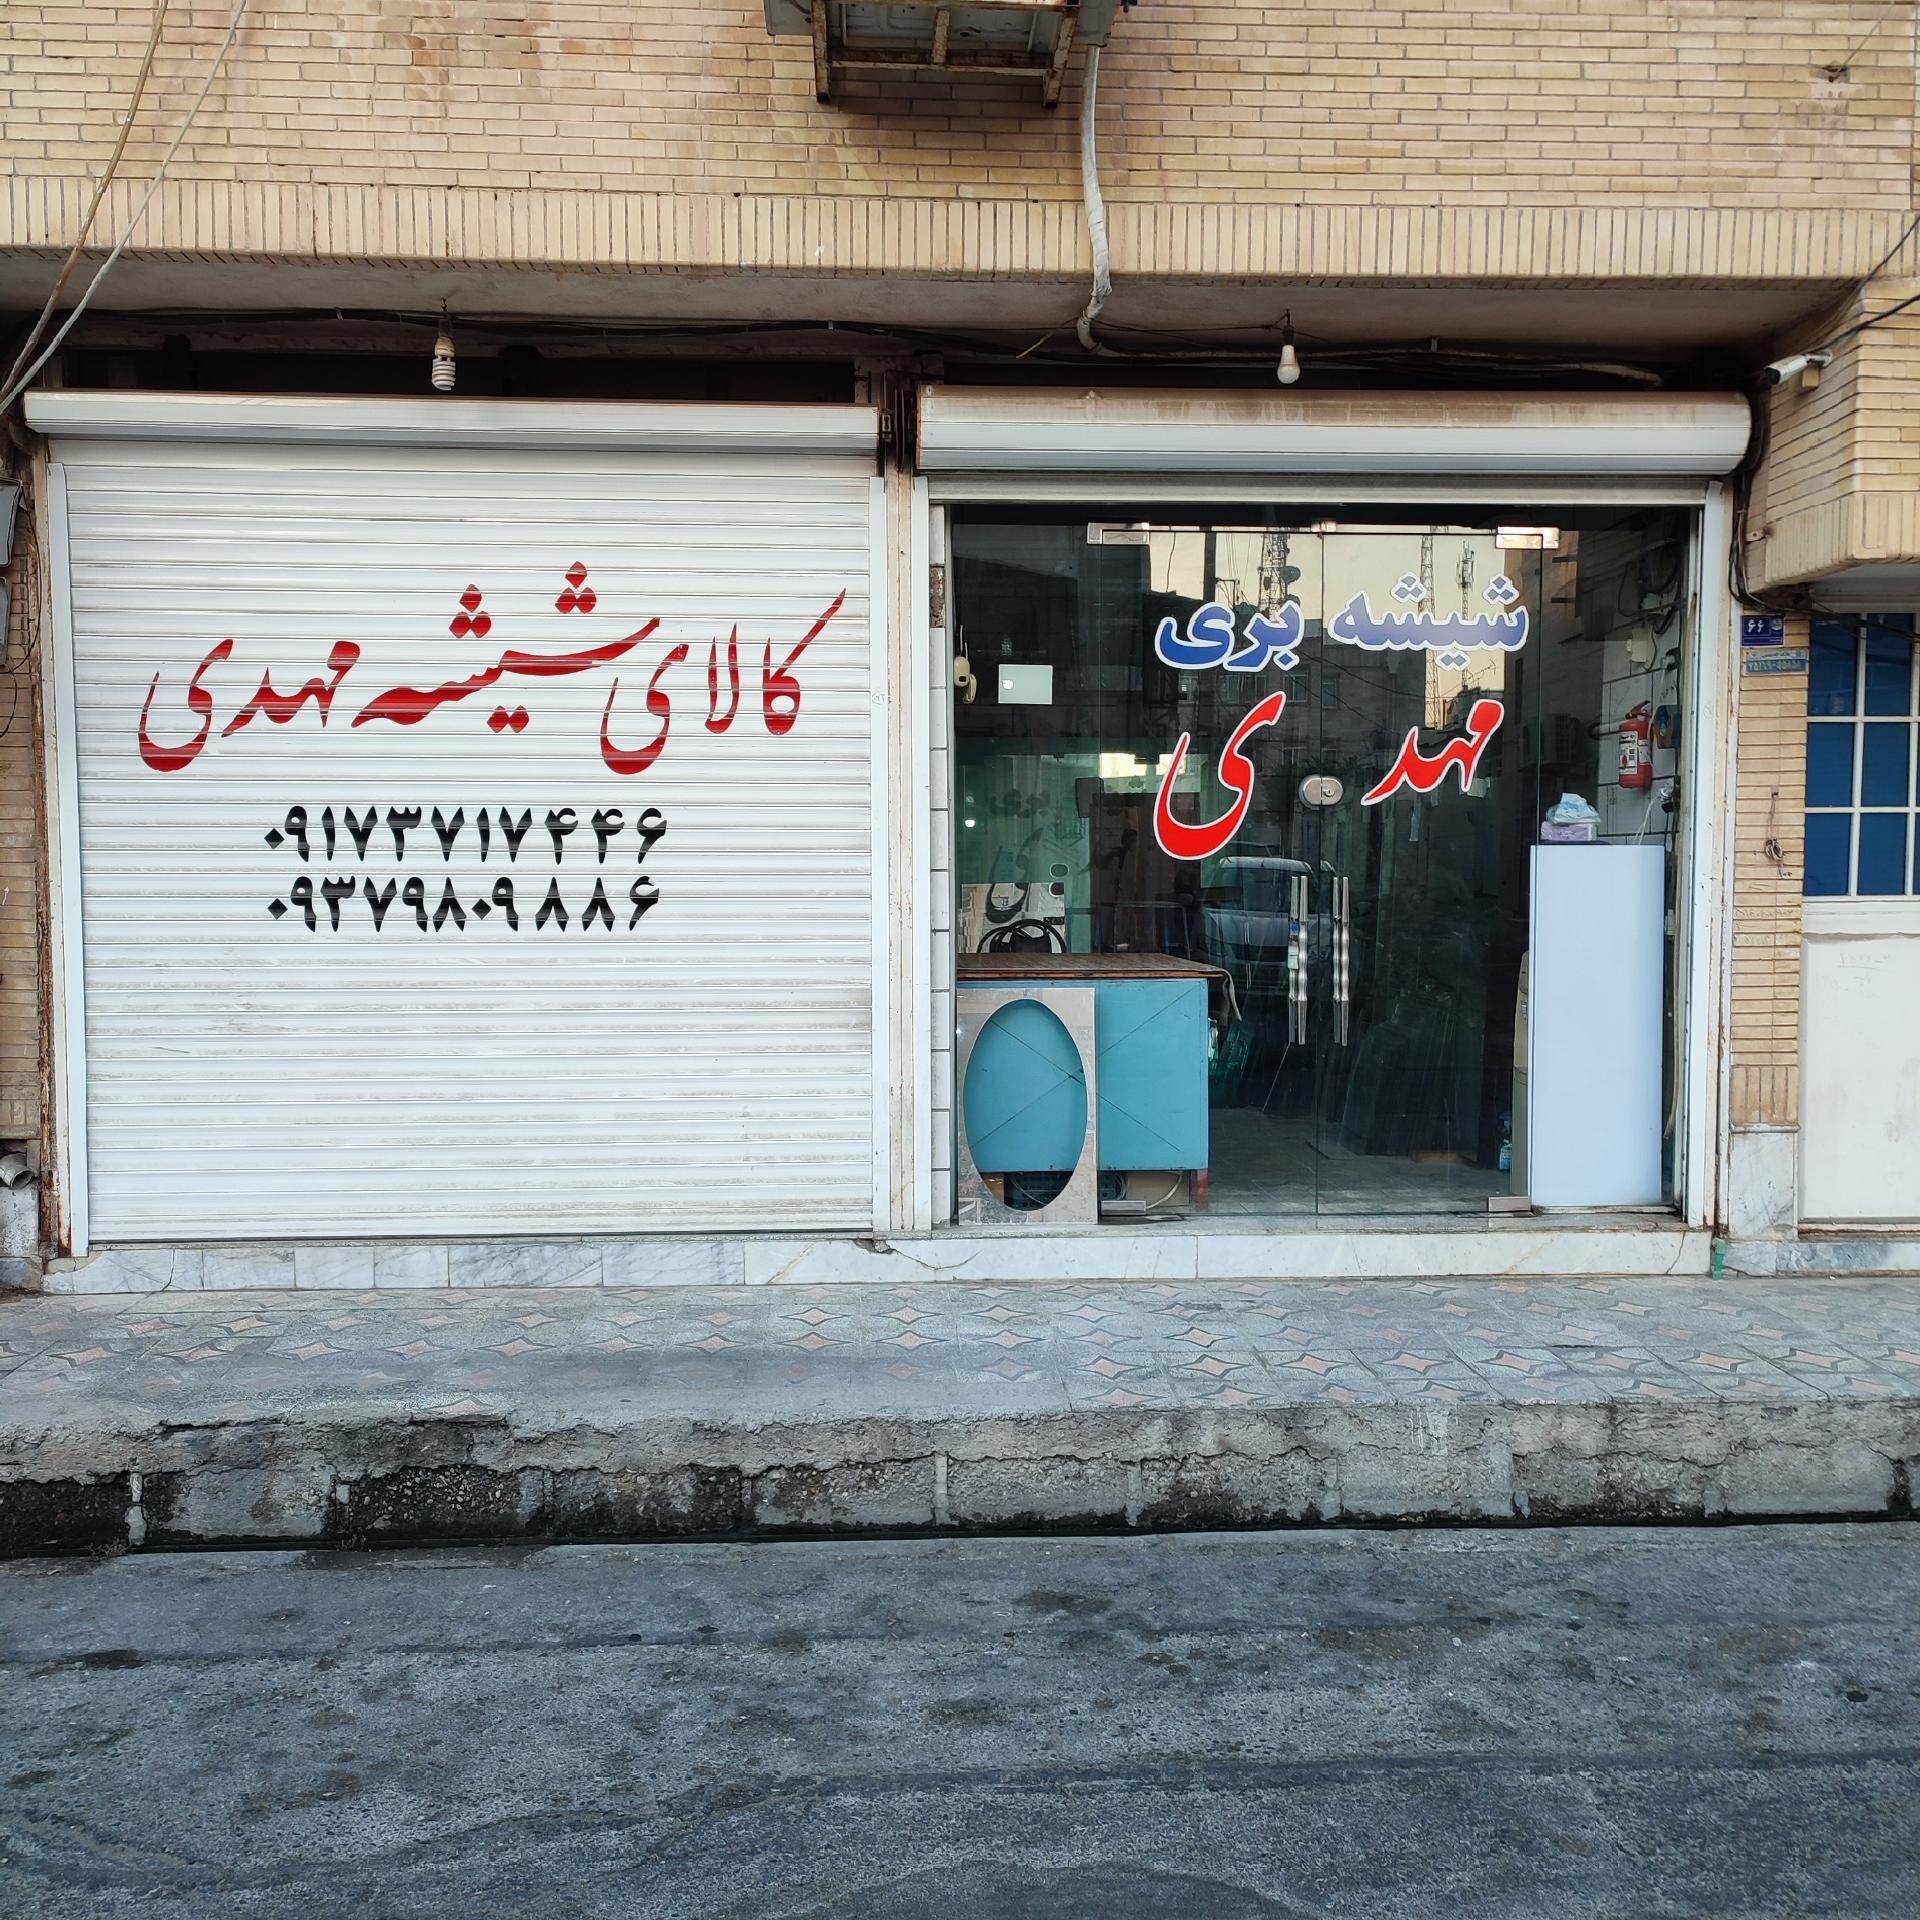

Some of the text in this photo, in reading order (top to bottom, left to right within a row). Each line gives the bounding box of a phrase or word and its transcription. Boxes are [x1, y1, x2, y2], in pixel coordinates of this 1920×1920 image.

[138, 561, 846, 775] کالای شیشه مهدی
[1155, 572, 1529, 672] شیشه بری
[1154, 692, 1504, 860] مهدی
[264, 806, 667, 864] ۰۹۱۷۳۷۱۷۴۴۶
[268, 876, 660, 933] ۰۹۳۷۹۸۰۹۸۸۶
